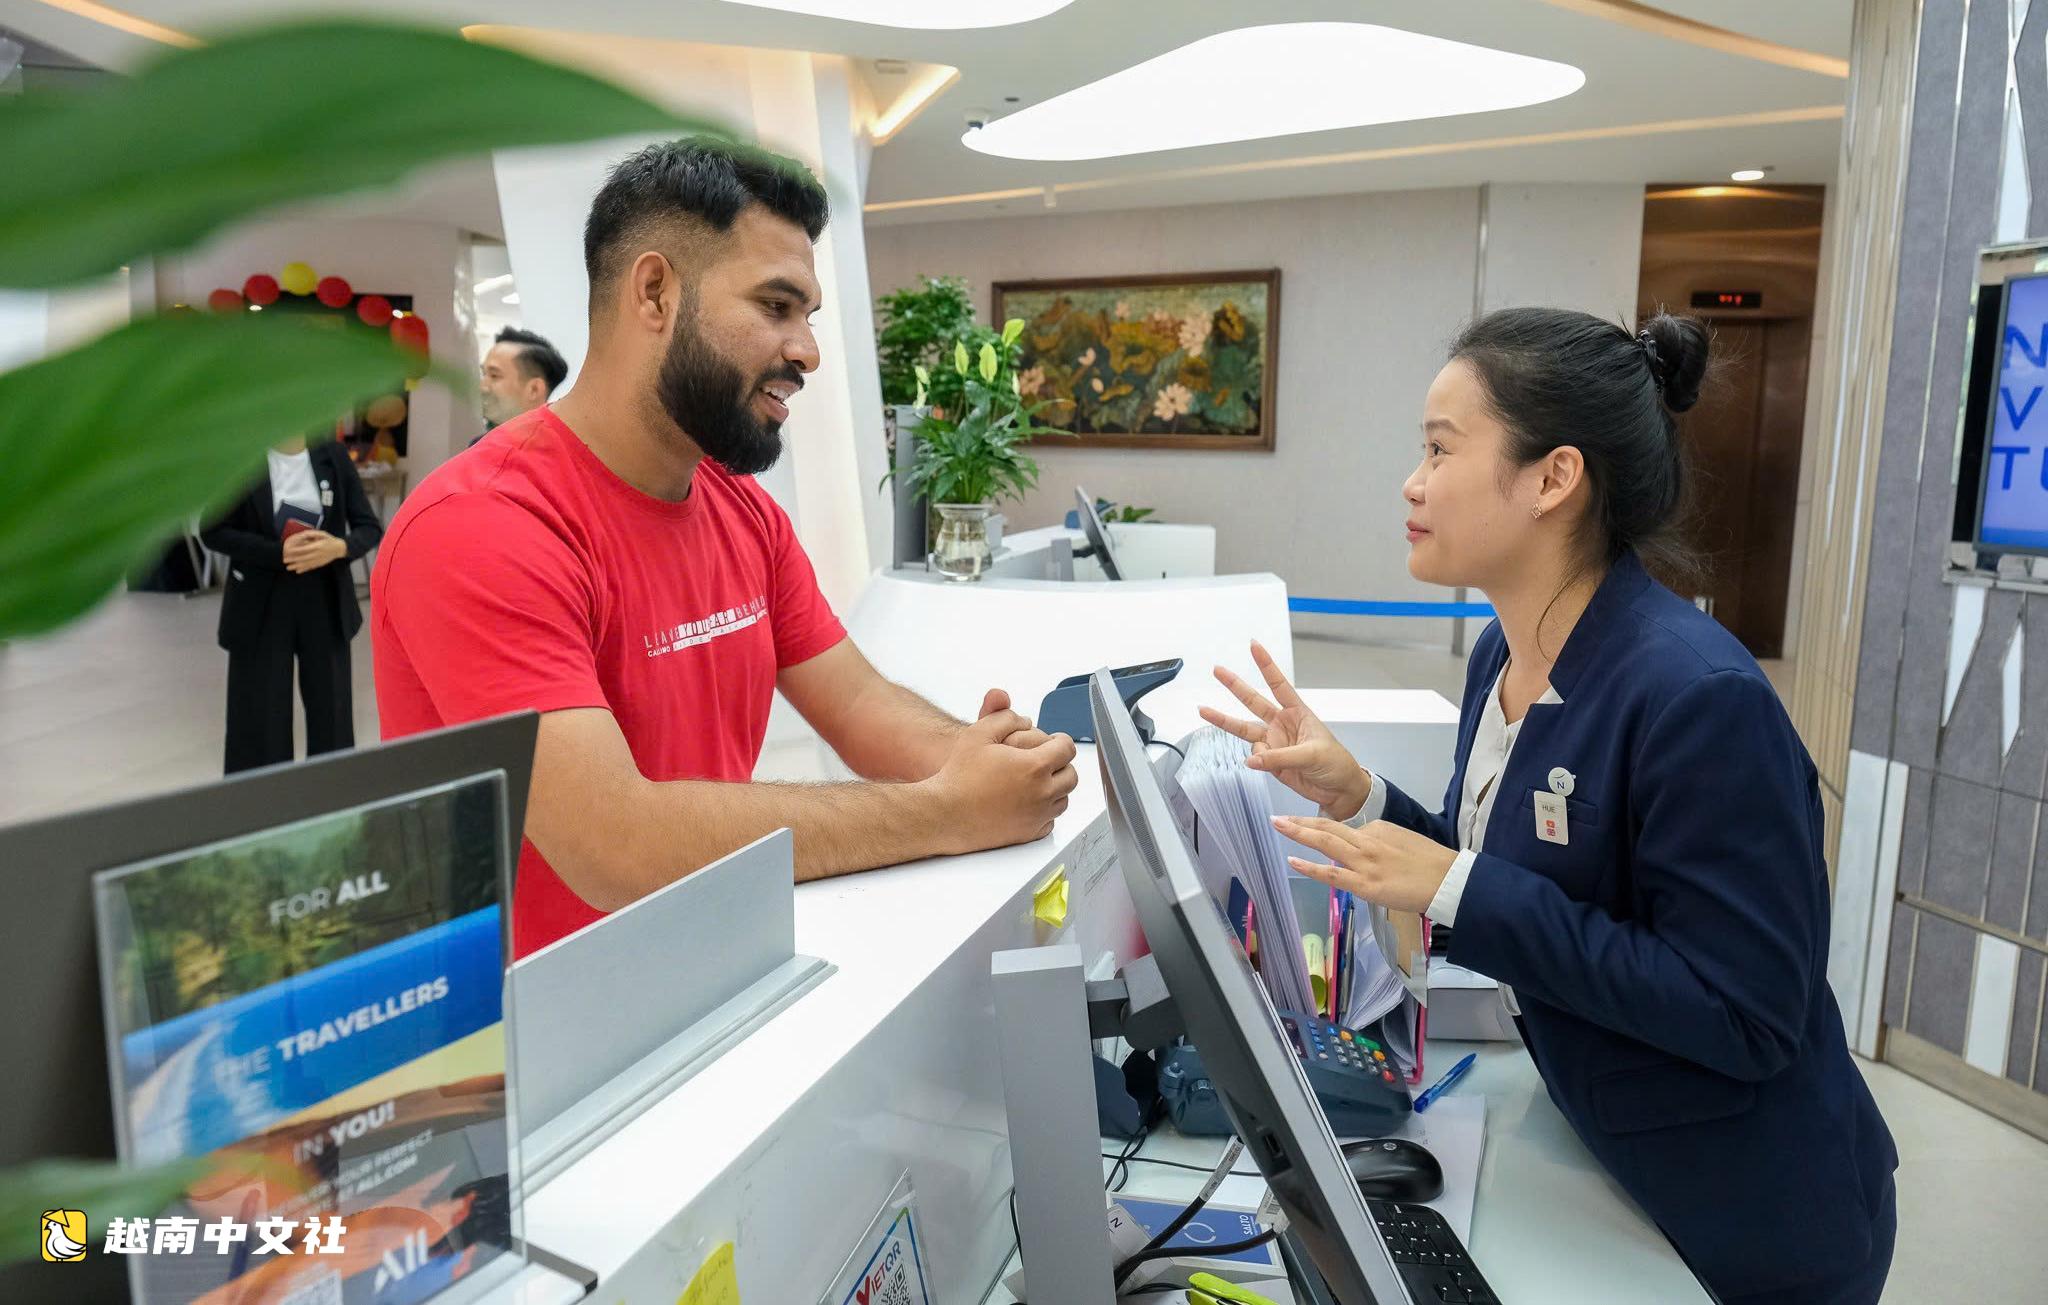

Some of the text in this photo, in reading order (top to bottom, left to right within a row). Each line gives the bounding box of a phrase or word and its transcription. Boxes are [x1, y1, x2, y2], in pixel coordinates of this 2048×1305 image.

[268, 869, 390, 926] FOR ALL
[276, 975, 450, 1062] TRAVELLERS
[292, 1100, 396, 1166] IN YOU!
[1238, 1214, 1254, 1236] SALTO
[856, 1240, 901, 1305] VIETQR
